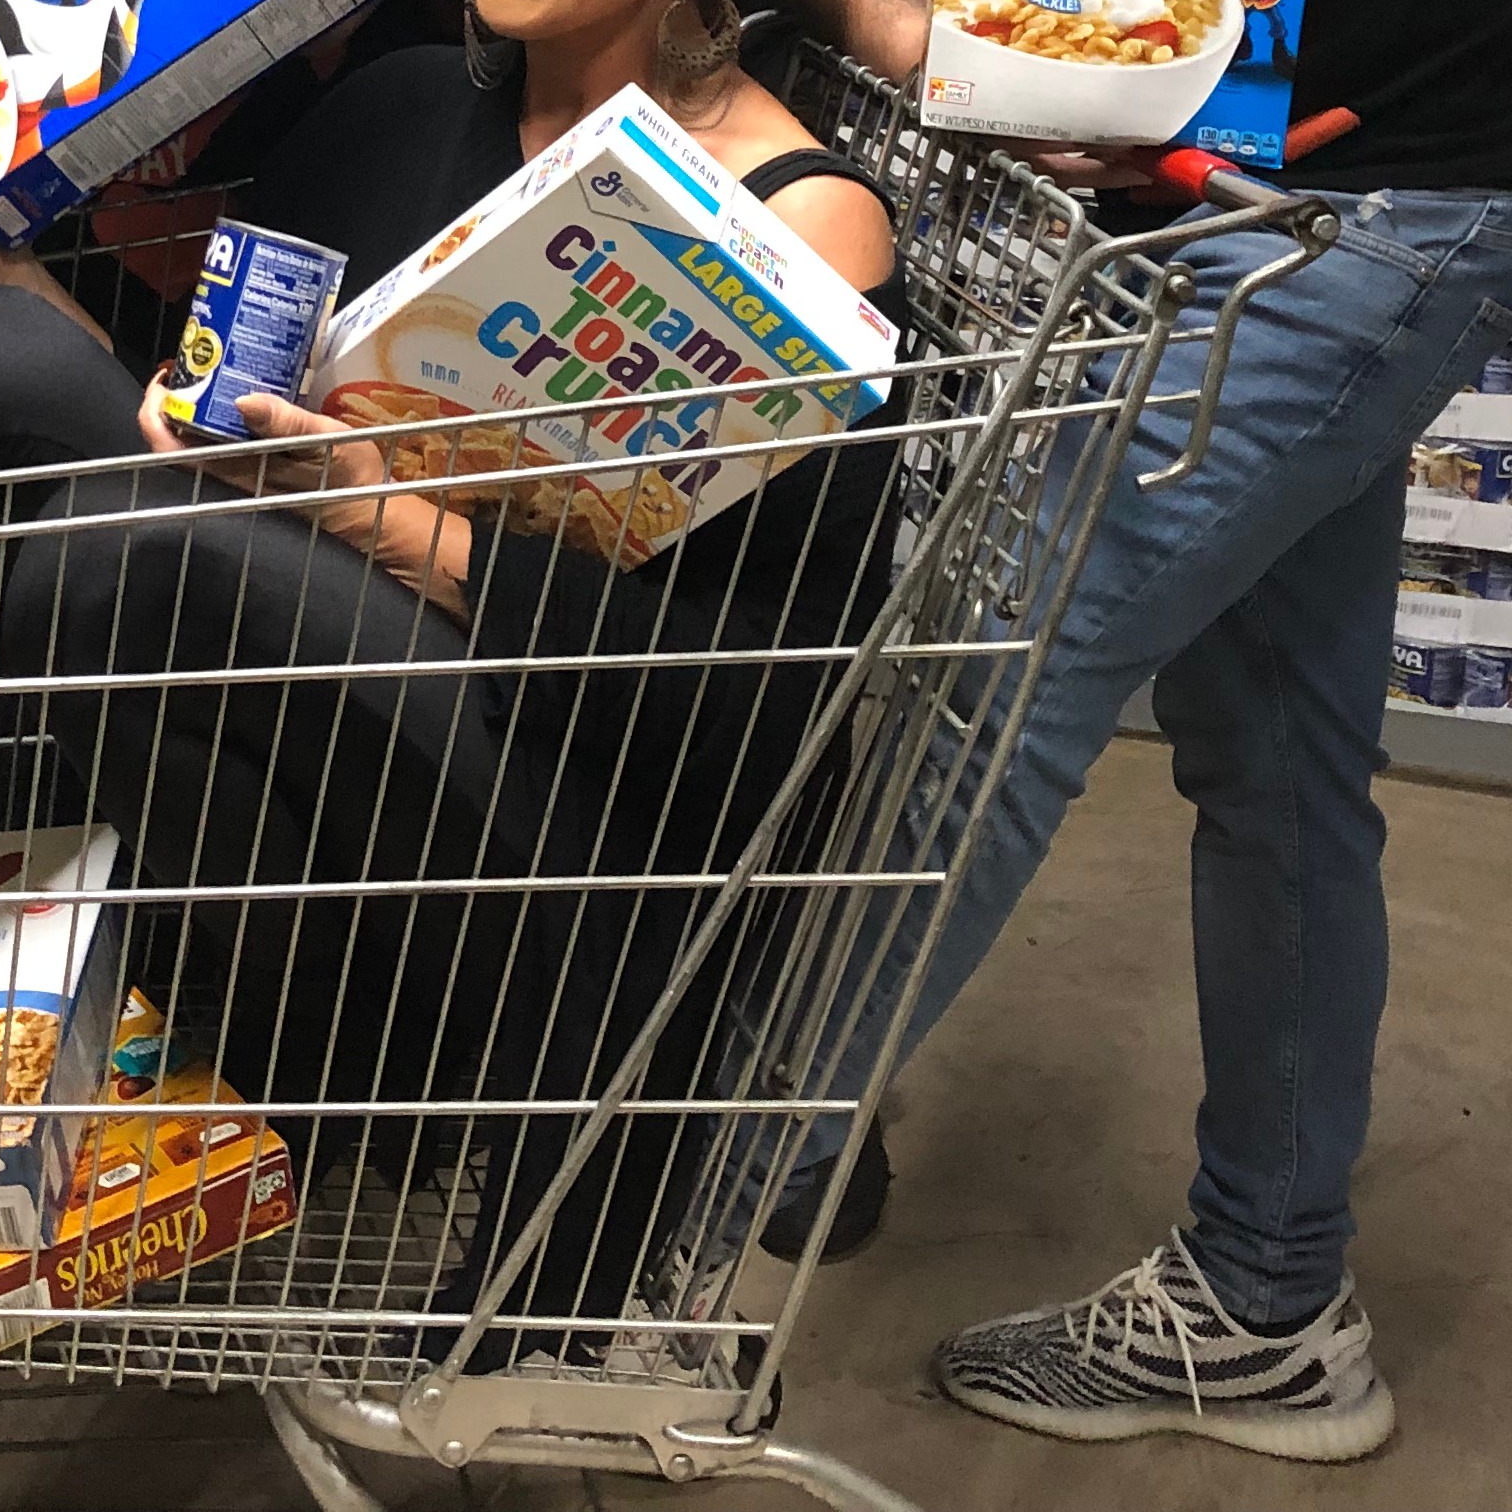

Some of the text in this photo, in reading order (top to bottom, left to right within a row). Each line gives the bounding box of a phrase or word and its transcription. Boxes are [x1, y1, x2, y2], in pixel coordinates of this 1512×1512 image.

[637, 104, 721, 190] WHOLE GRAIN
[925, 112, 943, 124] NET
[728, 238, 784, 290] Crunch
[730, 216, 788, 269] Cinnamon
[739, 233, 778, 271] Toast
[545, 224, 803, 427] Cinnamon
[677, 243, 785, 340] LARGE
[476, 301, 722, 498] Crunch
[56, 1203, 209, 1292] Cheerios
